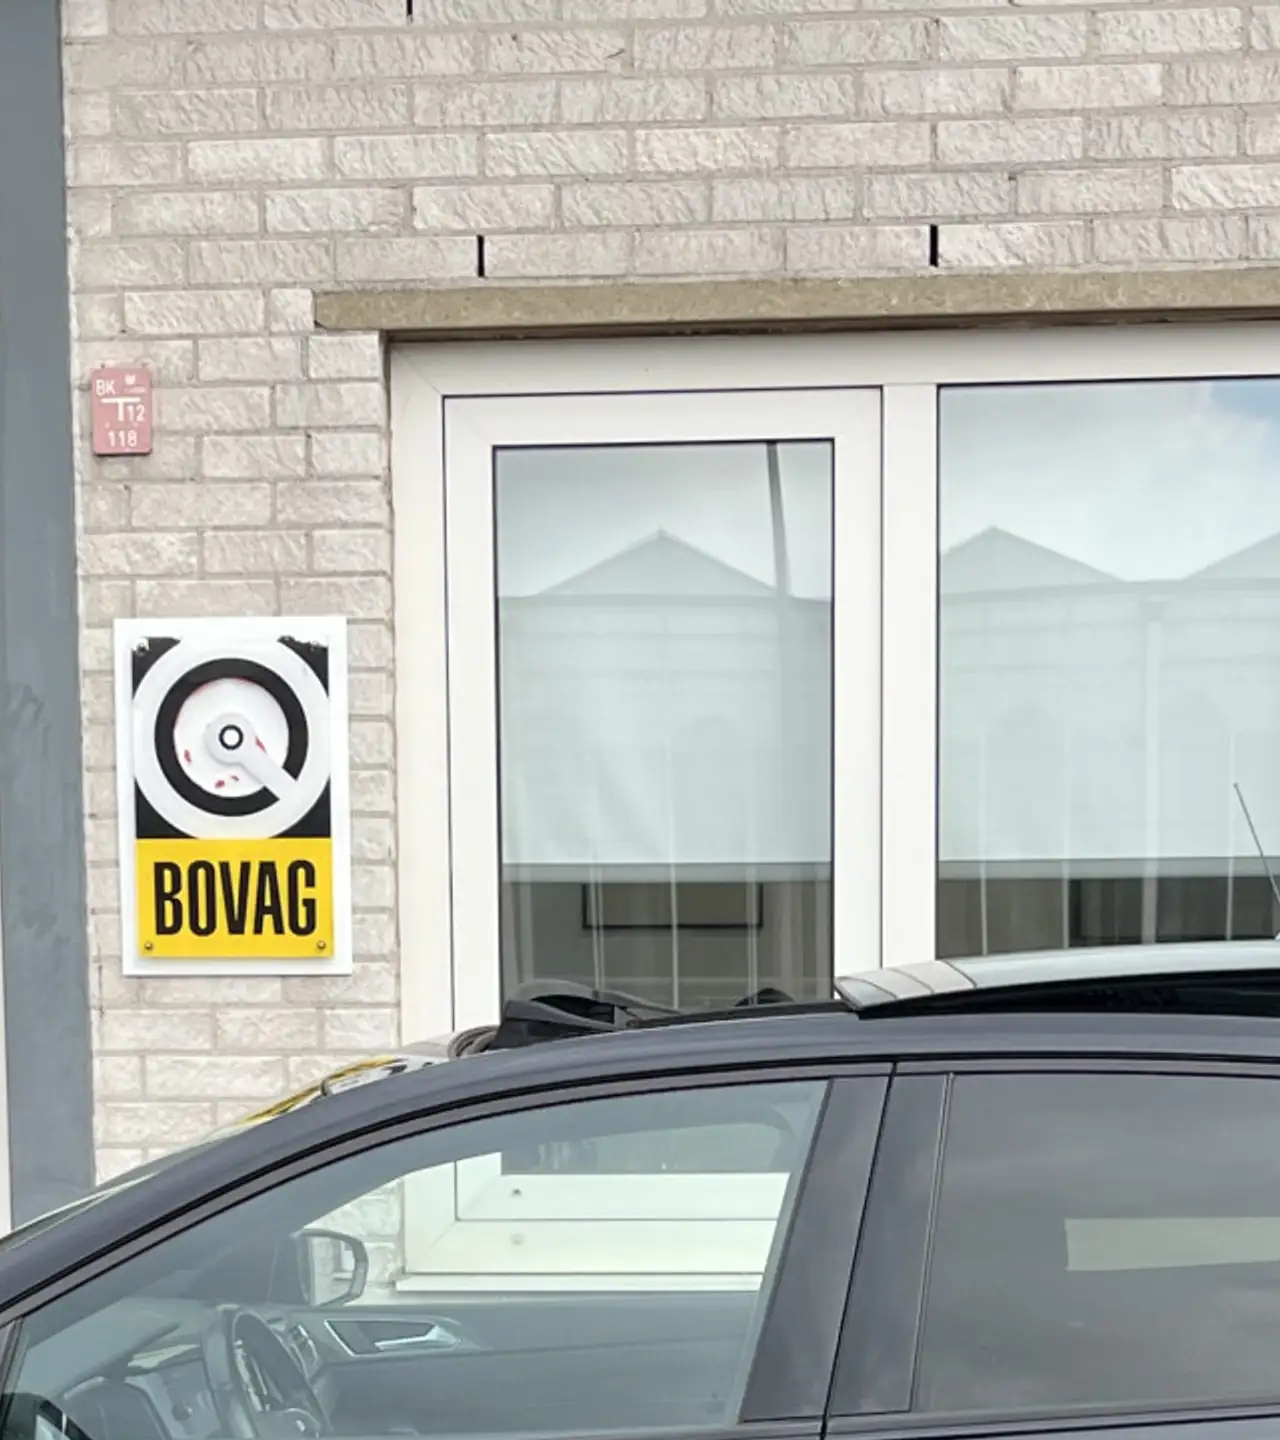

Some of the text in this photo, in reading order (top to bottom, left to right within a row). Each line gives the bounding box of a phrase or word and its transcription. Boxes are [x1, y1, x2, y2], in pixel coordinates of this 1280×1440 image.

[96, 379, 117, 397] BK
[108, 430, 138, 447] 118
[154, 860, 317, 936] BOVAG
